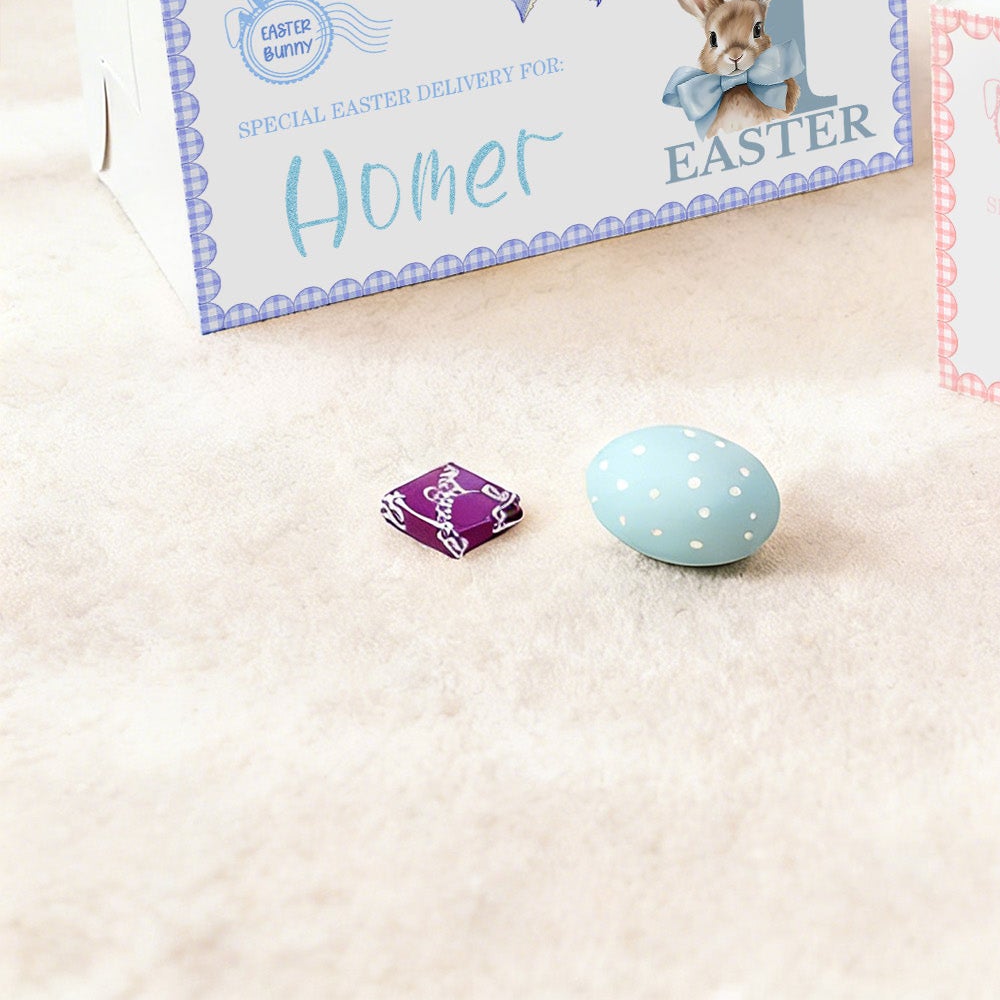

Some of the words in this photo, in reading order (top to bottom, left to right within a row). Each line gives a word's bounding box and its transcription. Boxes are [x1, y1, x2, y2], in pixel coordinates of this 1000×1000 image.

[260, 18, 312, 42] EASTER
[237, 105, 327, 142] SPECIAL
[330, 87, 412, 121] EASTER
[415, 65, 516, 104] DELIVERY
[519, 56, 565, 81] FOR:
[663, 103, 877, 185] EASTER
[284, 128, 564, 258] Homer
